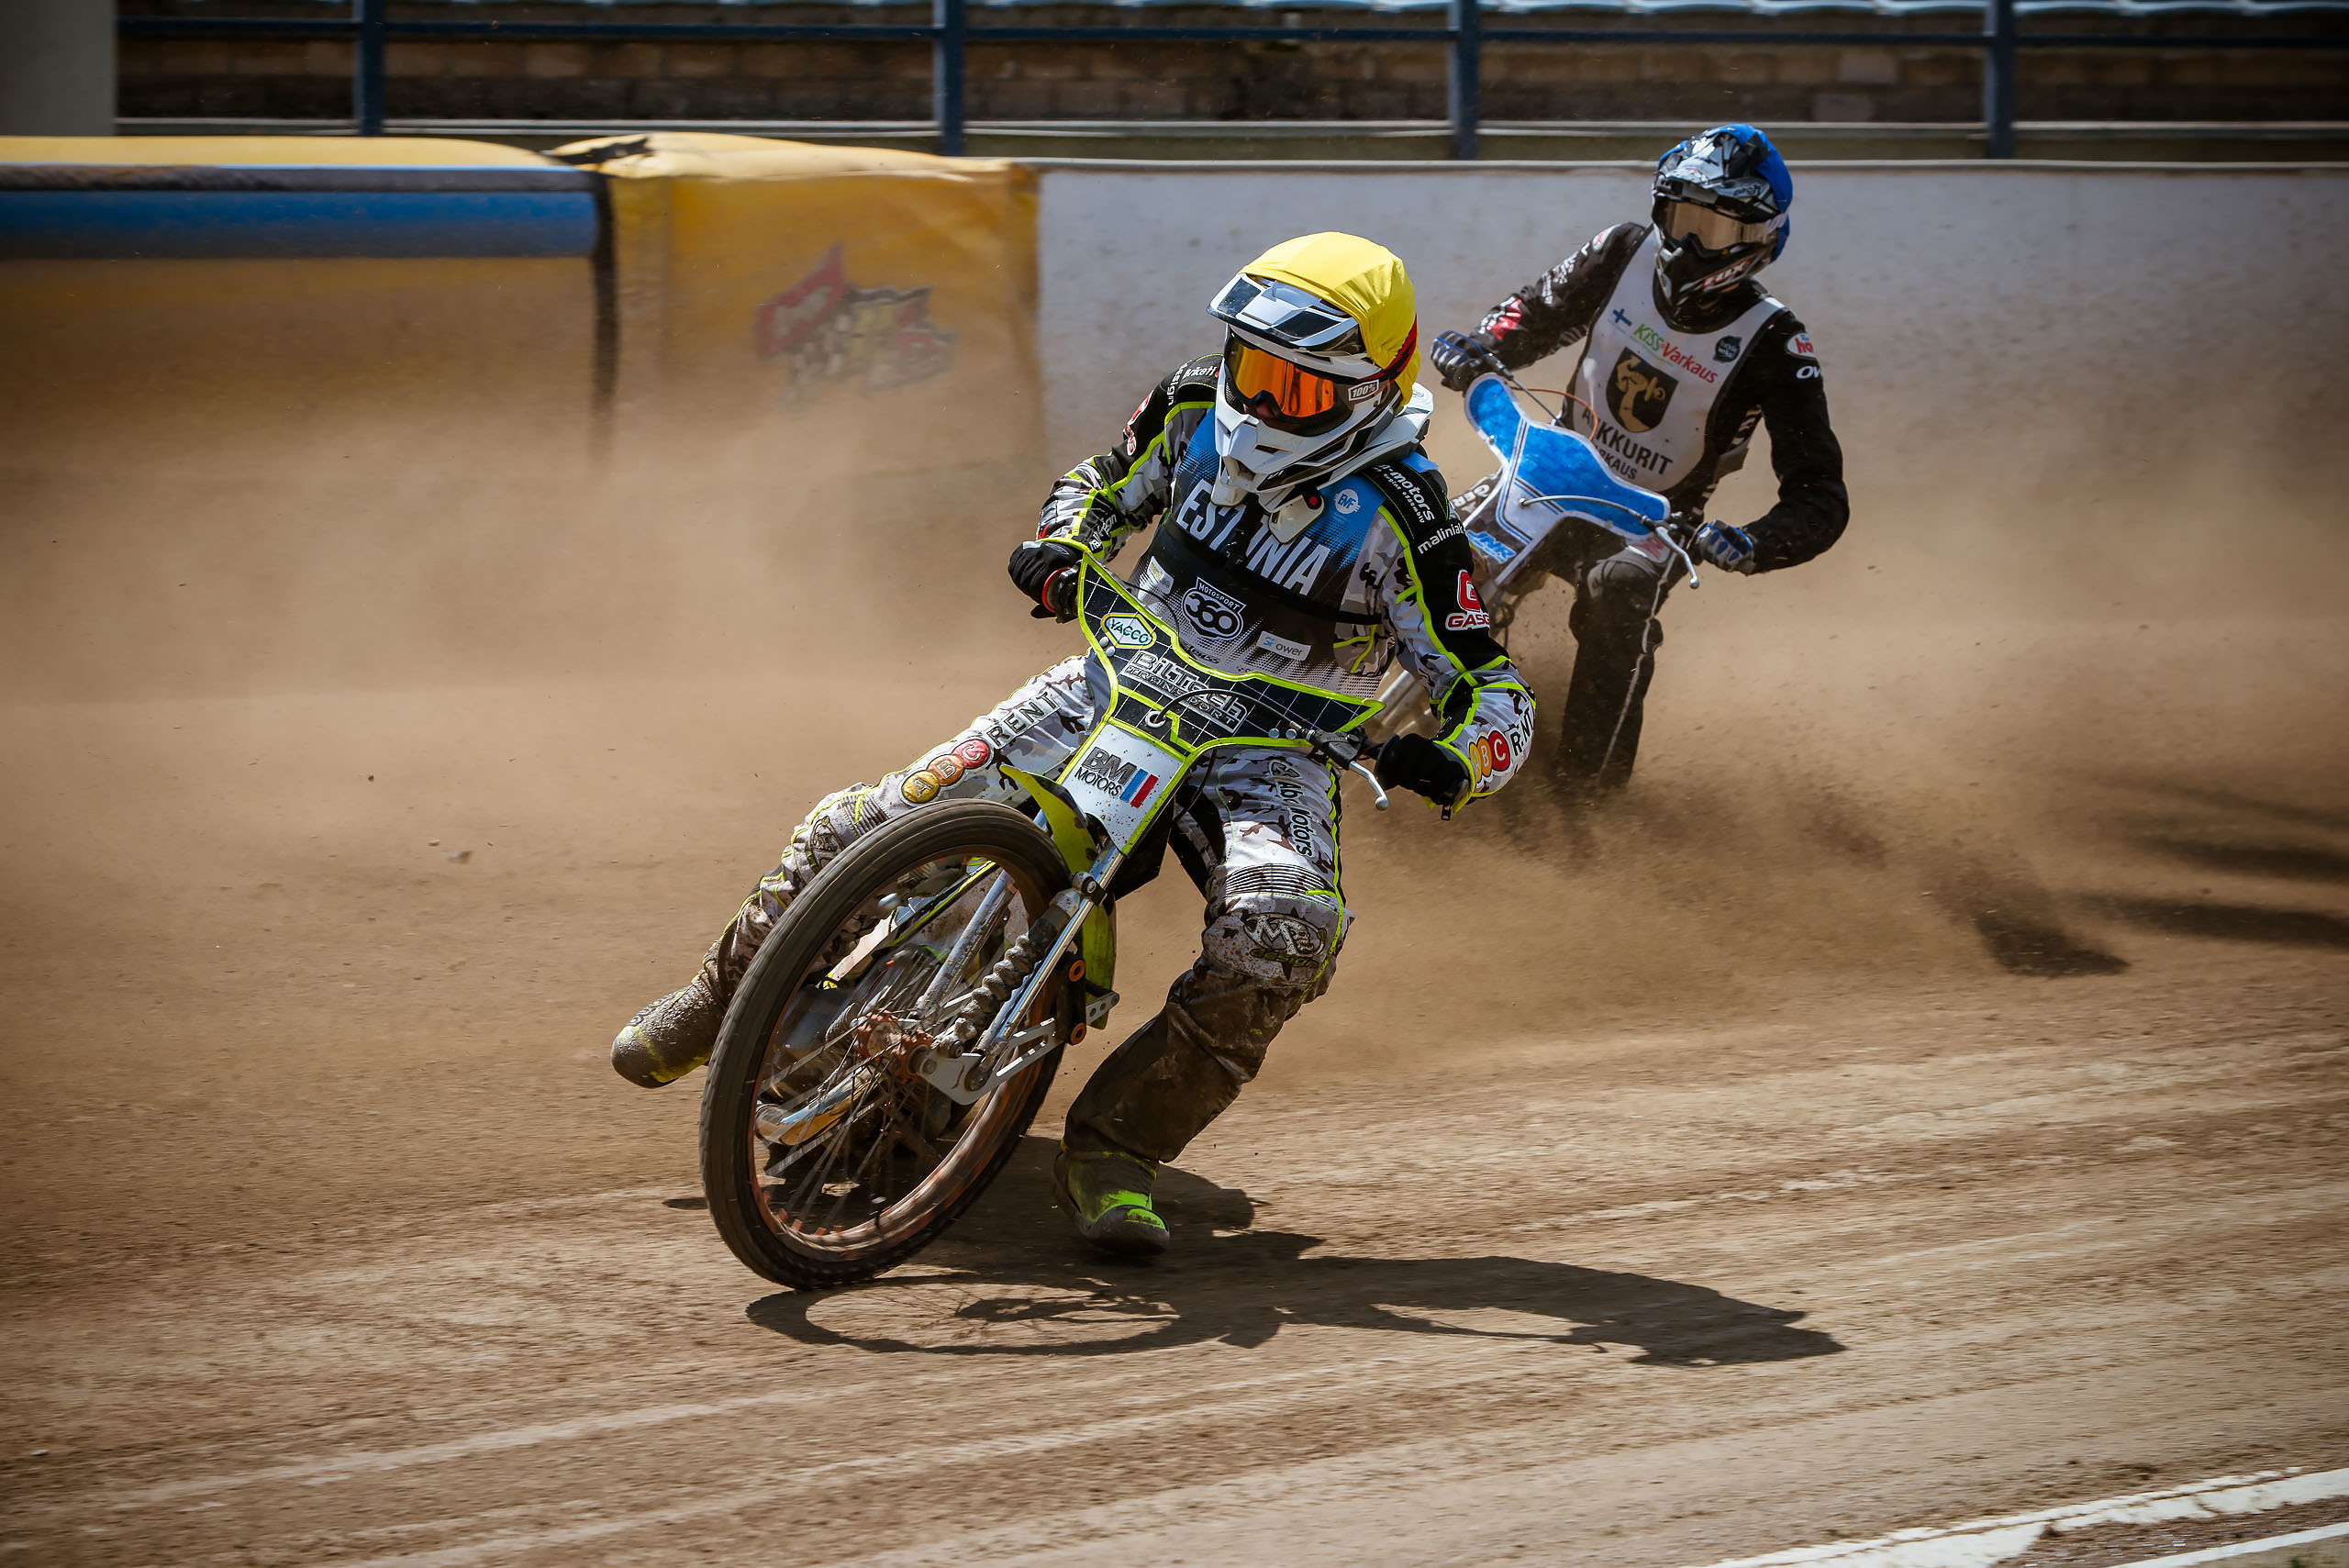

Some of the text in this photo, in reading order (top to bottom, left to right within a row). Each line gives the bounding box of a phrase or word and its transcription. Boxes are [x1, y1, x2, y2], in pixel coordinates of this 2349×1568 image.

[1662, 342, 1719, 384] Varkaus
[1352, 384, 1376, 398] 100%
[1582, 407, 1674, 475] AKKURIT
[1186, 593, 1240, 637] 360
[1198, 582, 1241, 611] MOTOSPORT
[1110, 618, 1149, 644] YACCO
[985, 691, 1060, 748] RENT
[1513, 705, 1534, 756] RNT
[1074, 766, 1122, 796] MOTORS
[1081, 746, 1138, 786] BM
